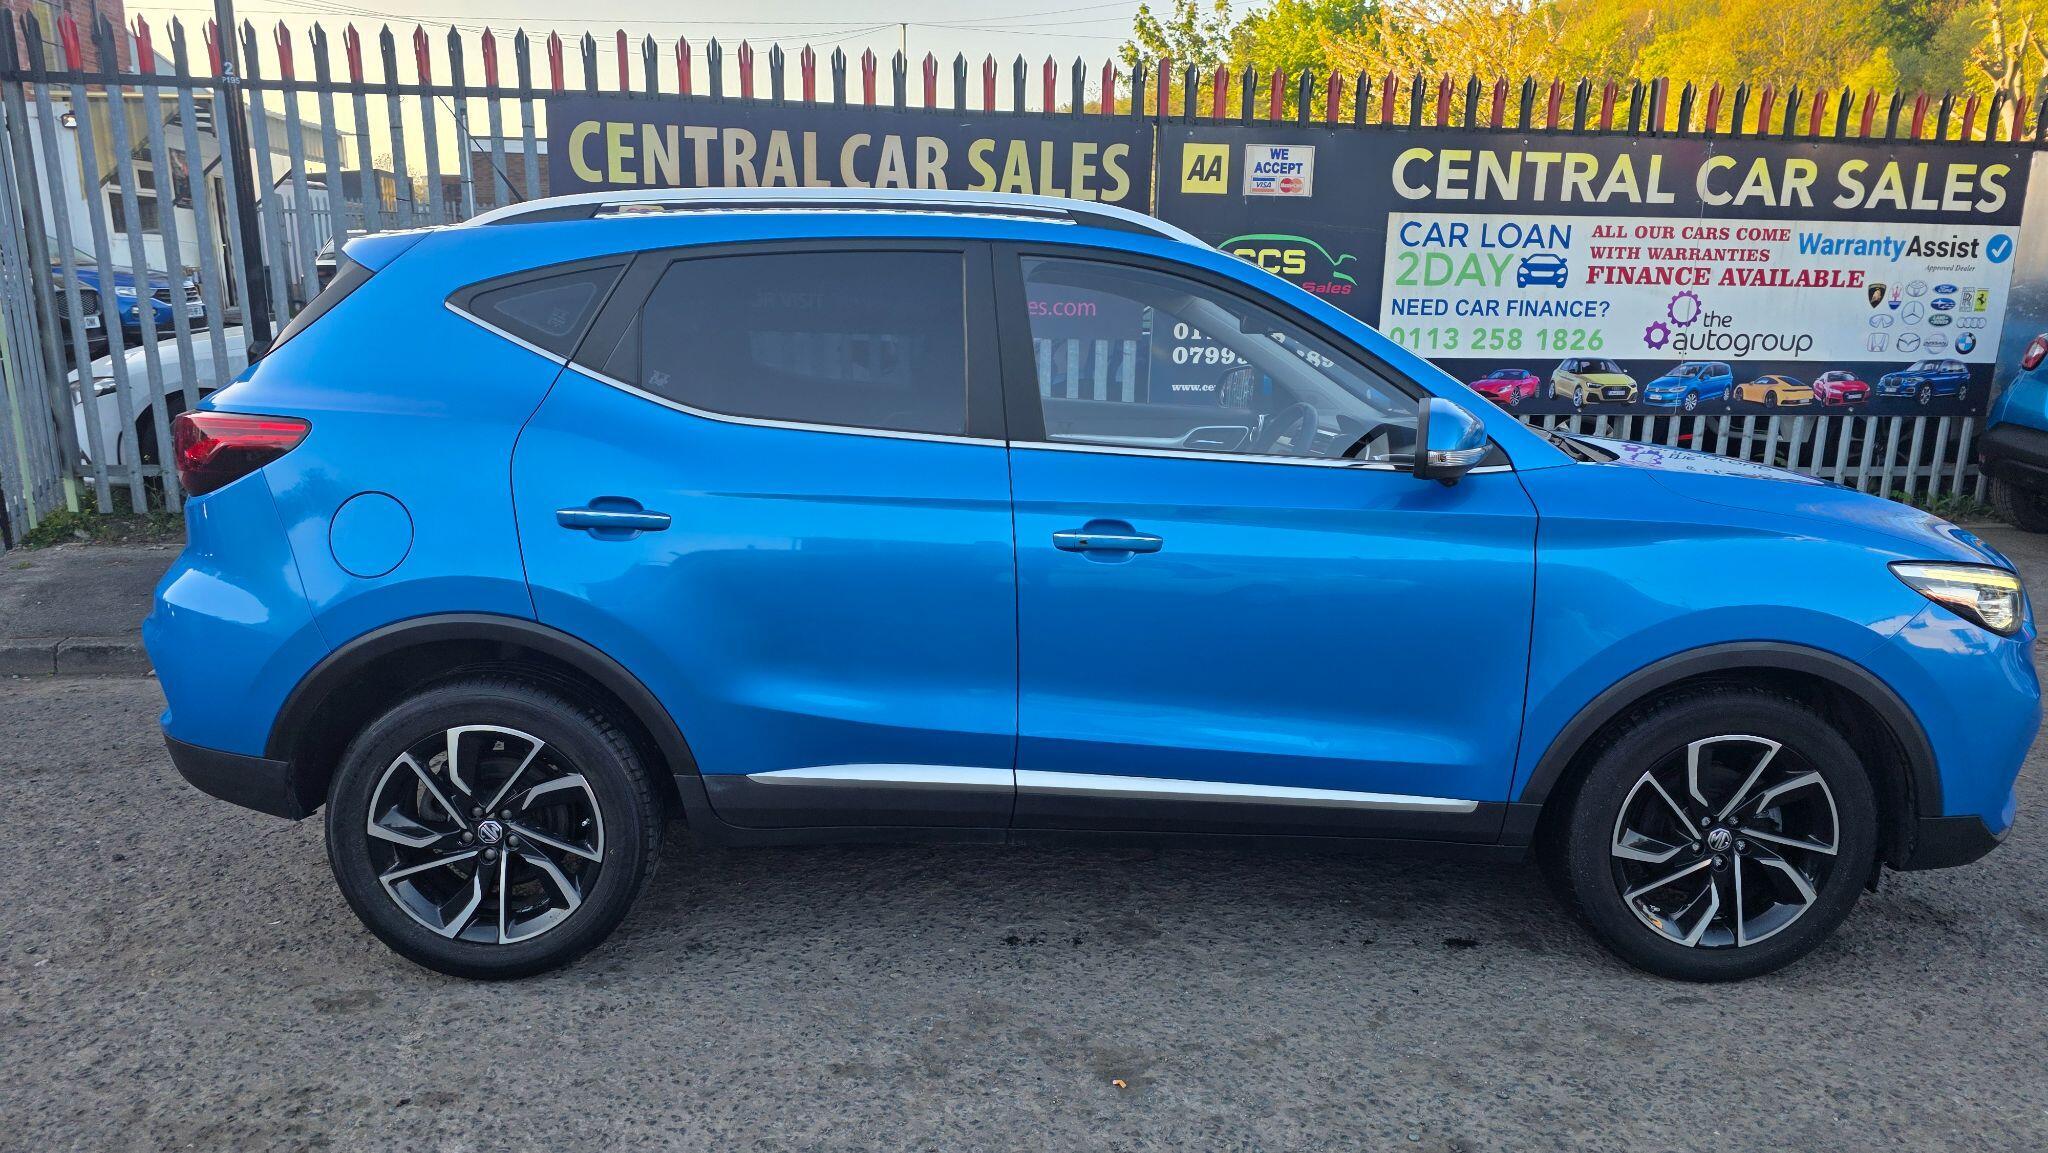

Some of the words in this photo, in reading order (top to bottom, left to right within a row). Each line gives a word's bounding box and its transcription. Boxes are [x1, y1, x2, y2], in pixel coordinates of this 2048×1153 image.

[223, 61, 234, 75] 2
[568, 120, 831, 188] CENTRAL
[840, 133, 949, 190] CAR
[968, 138, 1131, 202] SALES
[1270, 148, 1289, 160] WE
[1187, 155, 1222, 181] AA
[1254, 162, 1303, 174] ACCEPT
[1391, 147, 1675, 204] CENTRAL
[1696, 155, 1818, 207] CAR
[1832, 159, 2011, 213] SALES
[1400, 220, 1469, 247] CAR
[1481, 222, 1572, 249] LOAN
[1592, 225, 1627, 239] ALL
[1634, 225, 1675, 239] OUR
[1681, 226, 1730, 241] CARS
[1736, 227, 1791, 242] COME
[1590, 246, 1641, 260] WITH
[1648, 247, 1770, 262] WARRANTIES
[1395, 251, 1514, 287] 2DAY
[1586, 265, 1711, 286] FINANCE
[1718, 268, 1865, 289] AVAILABLE
[1925, 264, 1954, 272] Approved
[1302, 281, 1352, 295] Sales
[1391, 298, 1448, 316] NEED
[1455, 299, 1500, 317] CAR
[1506, 299, 1610, 318] FINANCE?
[1703, 311, 1733, 328] the
[1389, 326, 1459, 350] 0113
[1471, 327, 1523, 350] 258
[1536, 328, 1604, 351] 1826
[1673, 329, 1813, 357] autogroup
[1172, 384, 1216, 392] www.ce
